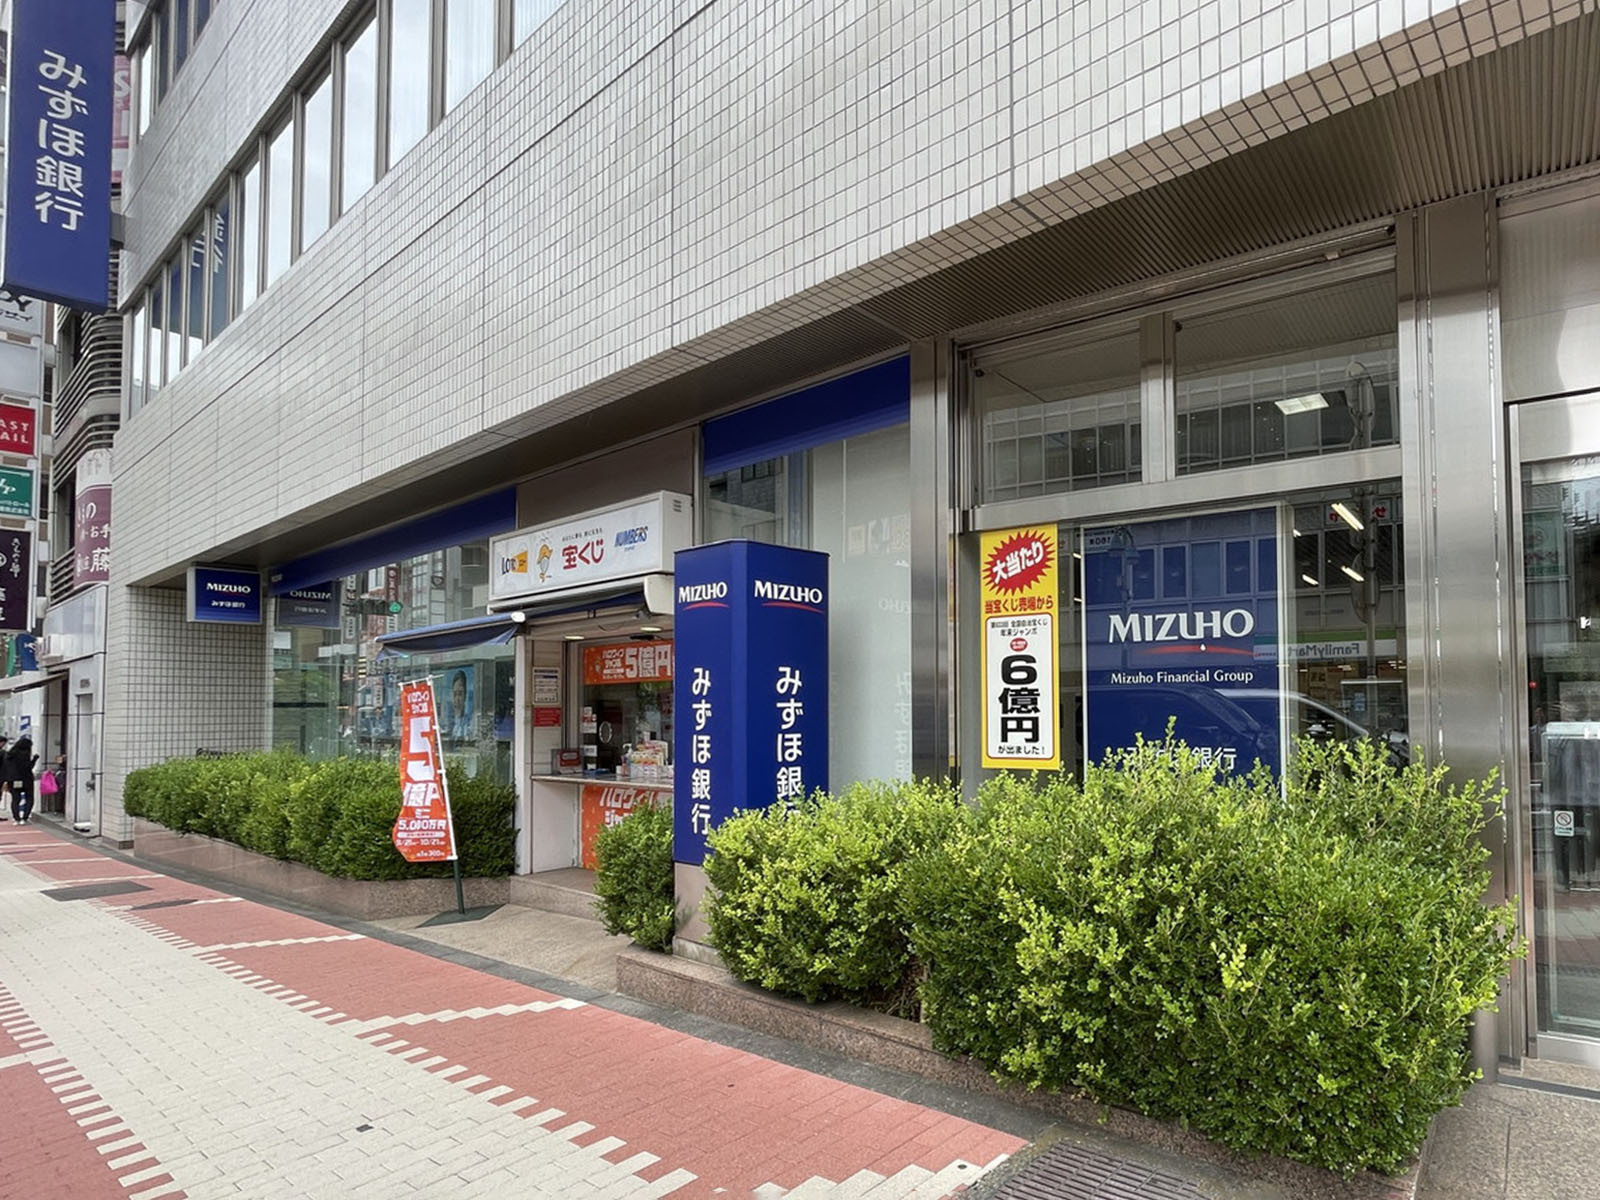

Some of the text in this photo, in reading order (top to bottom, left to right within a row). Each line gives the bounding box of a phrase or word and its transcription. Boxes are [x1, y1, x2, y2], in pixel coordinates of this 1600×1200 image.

[35, 50, 88, 231] みずほ銀行
[562, 539, 604, 570] 宝くじ
[993, 541, 1044, 584] 大当たり
[207, 582, 251, 594] MIZUHO
[679, 582, 728, 603] MIZUHO
[754, 580, 823, 604] MIZUHO
[985, 595, 1054, 614] 当宝くじ売場から
[1108, 609, 1254, 643] MIZUHO
[625, 644, 672, 679] 5億円
[1111, 670, 1253, 684] Mizuho Financial Group
[998, 654, 1041, 744] 6億円
[692, 667, 712, 836] みずほ銀行
